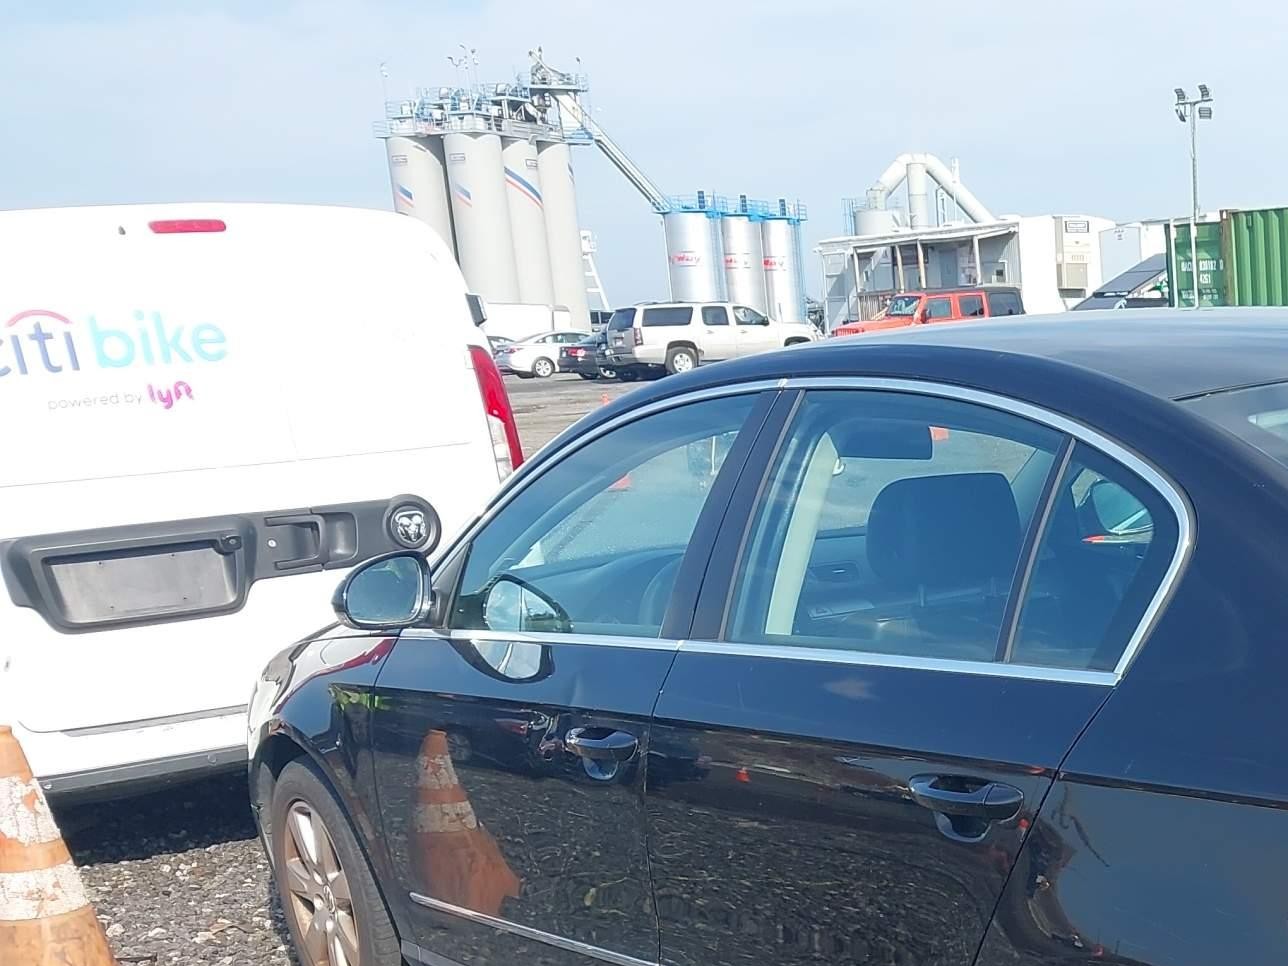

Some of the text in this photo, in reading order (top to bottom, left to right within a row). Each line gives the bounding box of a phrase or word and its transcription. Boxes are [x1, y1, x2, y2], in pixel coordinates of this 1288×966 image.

[88, 309, 228, 368] bike
[48, 392, 119, 410] powered
[124, 391, 143, 405] by
